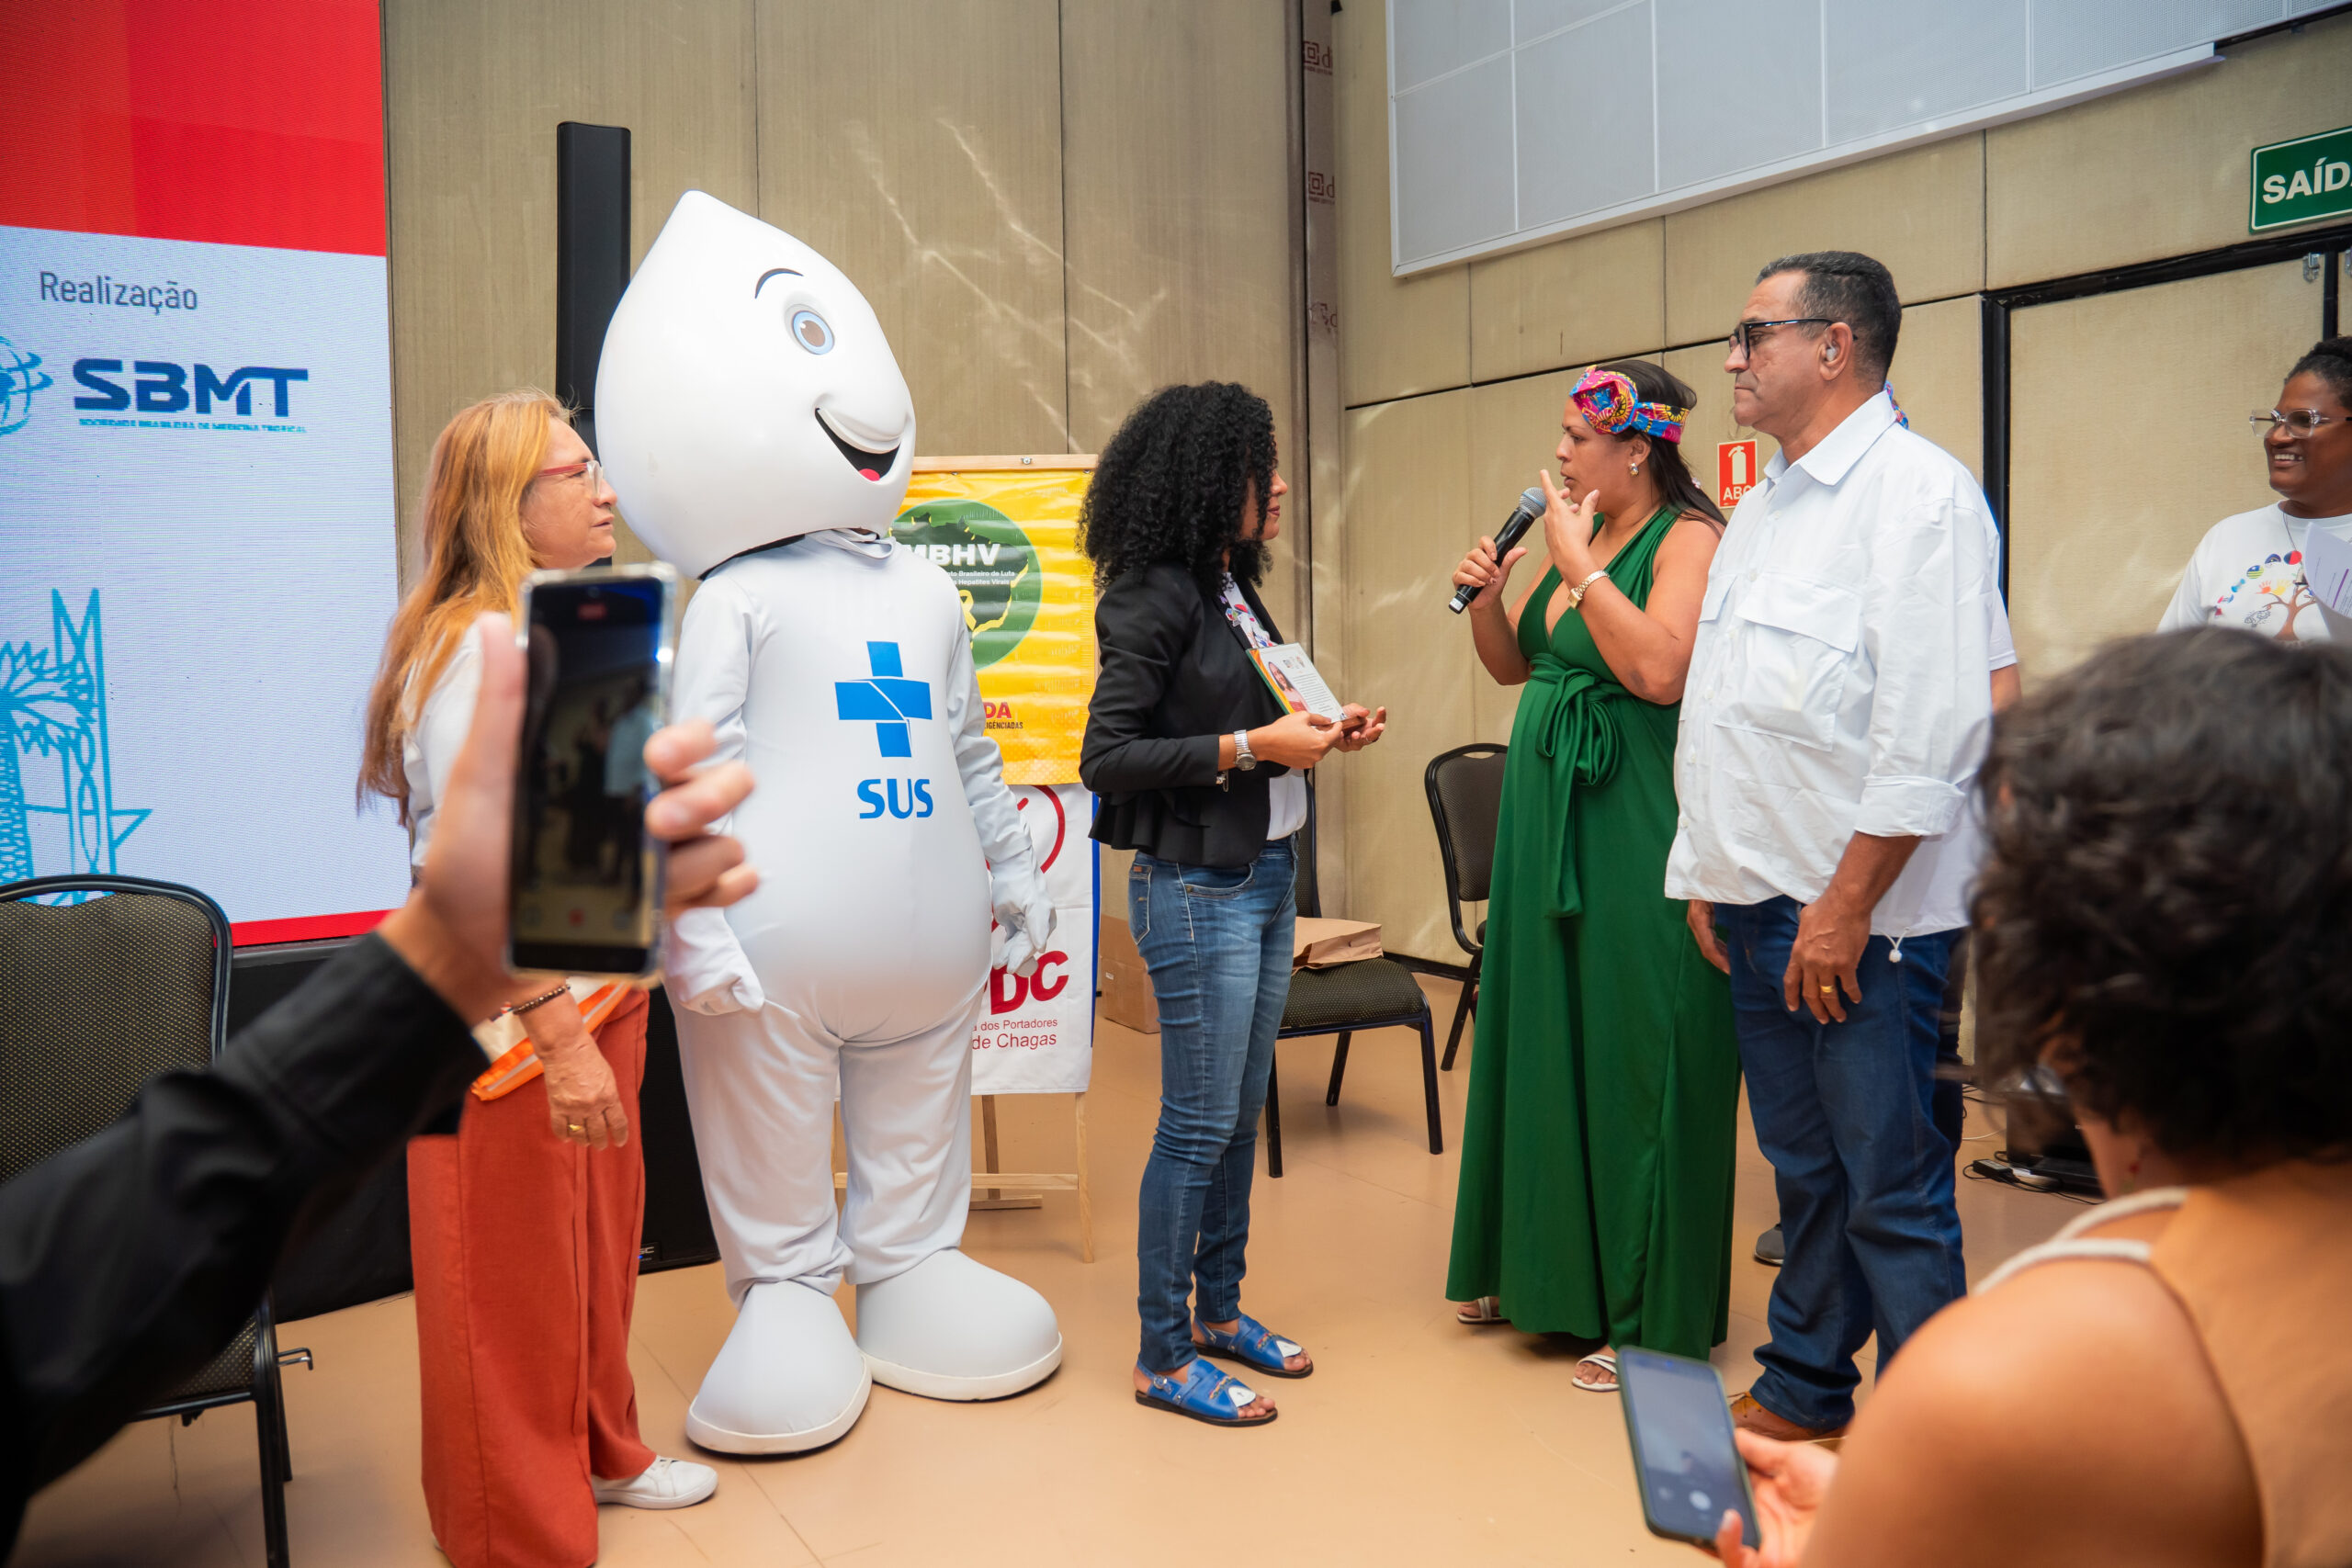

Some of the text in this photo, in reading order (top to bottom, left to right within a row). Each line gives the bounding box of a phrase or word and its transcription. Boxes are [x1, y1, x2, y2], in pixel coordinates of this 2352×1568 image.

[2262, 156, 2352, 204] SAÍD
[40, 271, 198, 315] Realização
[73, 357, 309, 418] SBMT
[856, 778, 933, 819] SUS
[984, 950, 1069, 1015] DC
[972, 1032, 1057, 1051] de Chagas
[980, 1021, 1000, 1032] dos
[1003, 1019, 1058, 1030] Portadores
